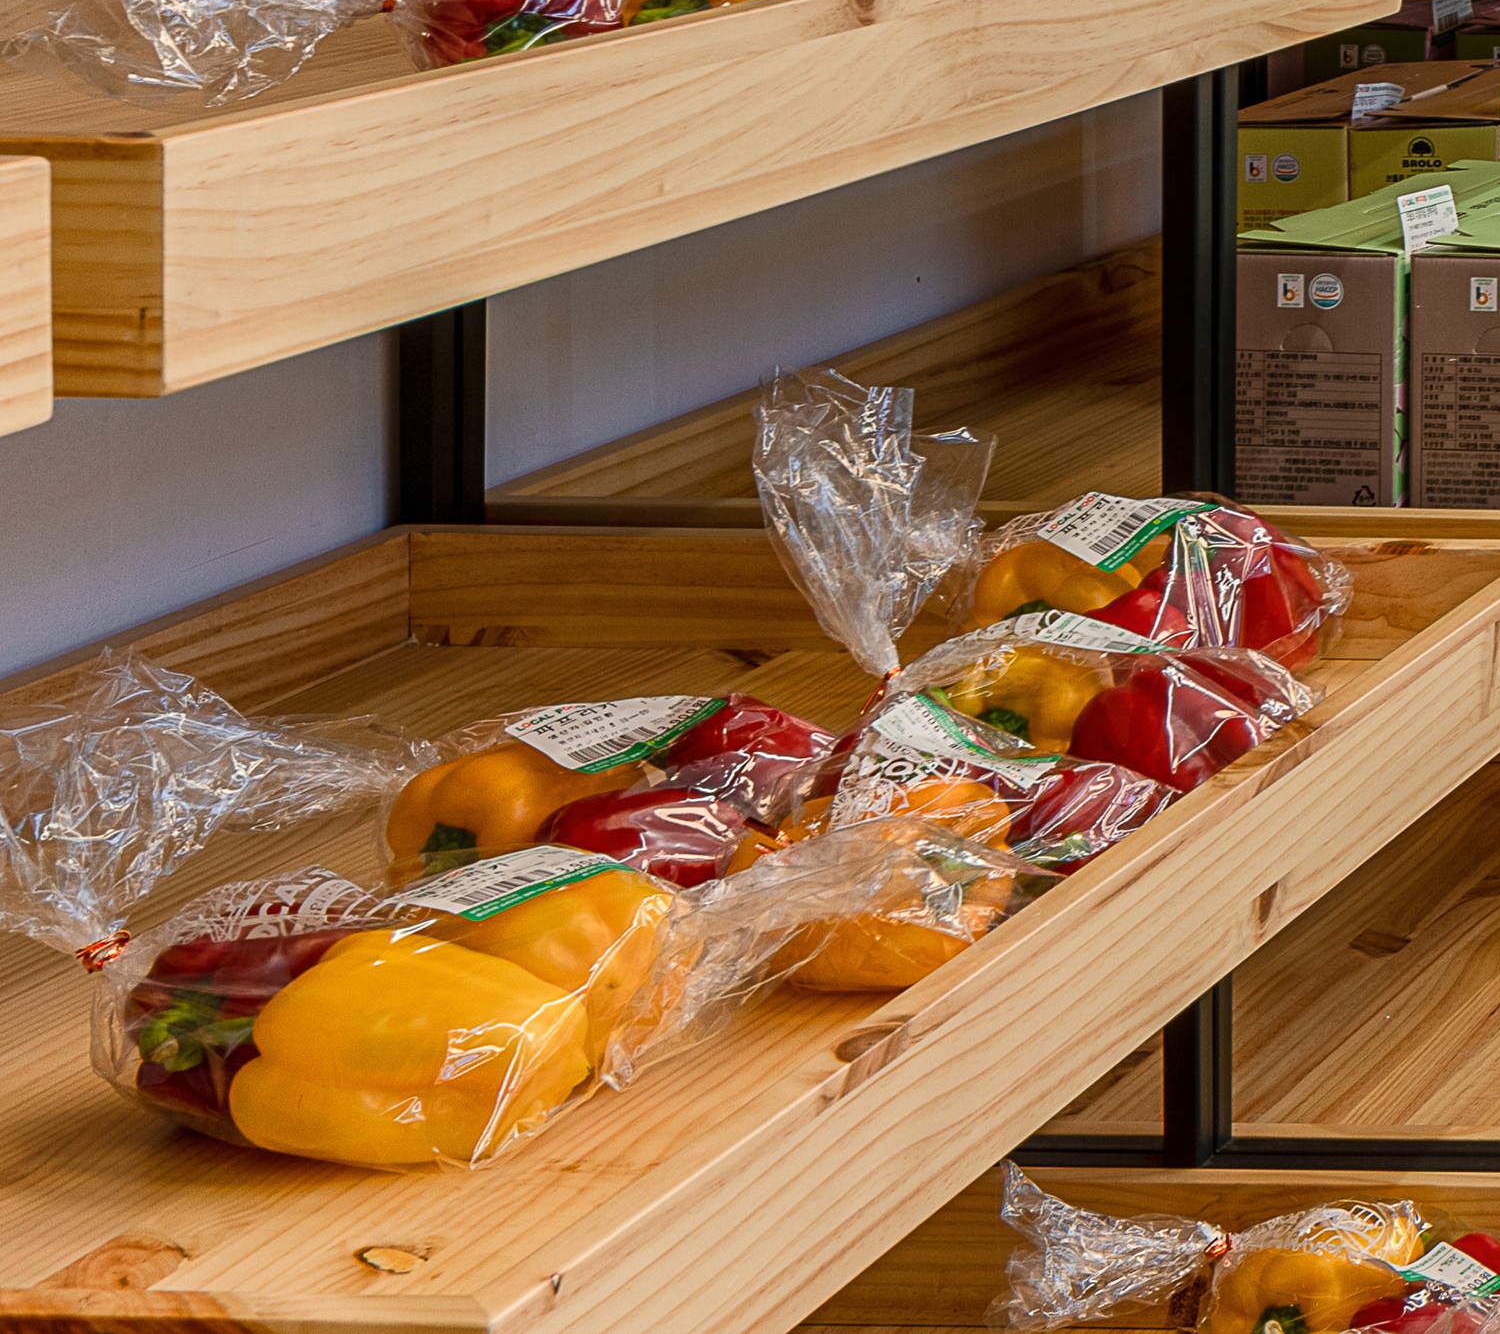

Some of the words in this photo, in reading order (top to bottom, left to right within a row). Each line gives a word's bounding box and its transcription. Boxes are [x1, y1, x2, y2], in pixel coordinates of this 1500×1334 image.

[1402, 158, 1442, 169] BROLO
[1046, 510, 1074, 534] LOCAL
[1061, 496, 1111, 533] 파프리
[515, 711, 552, 732] LOCAL
[533, 700, 618, 737] 파프리카
